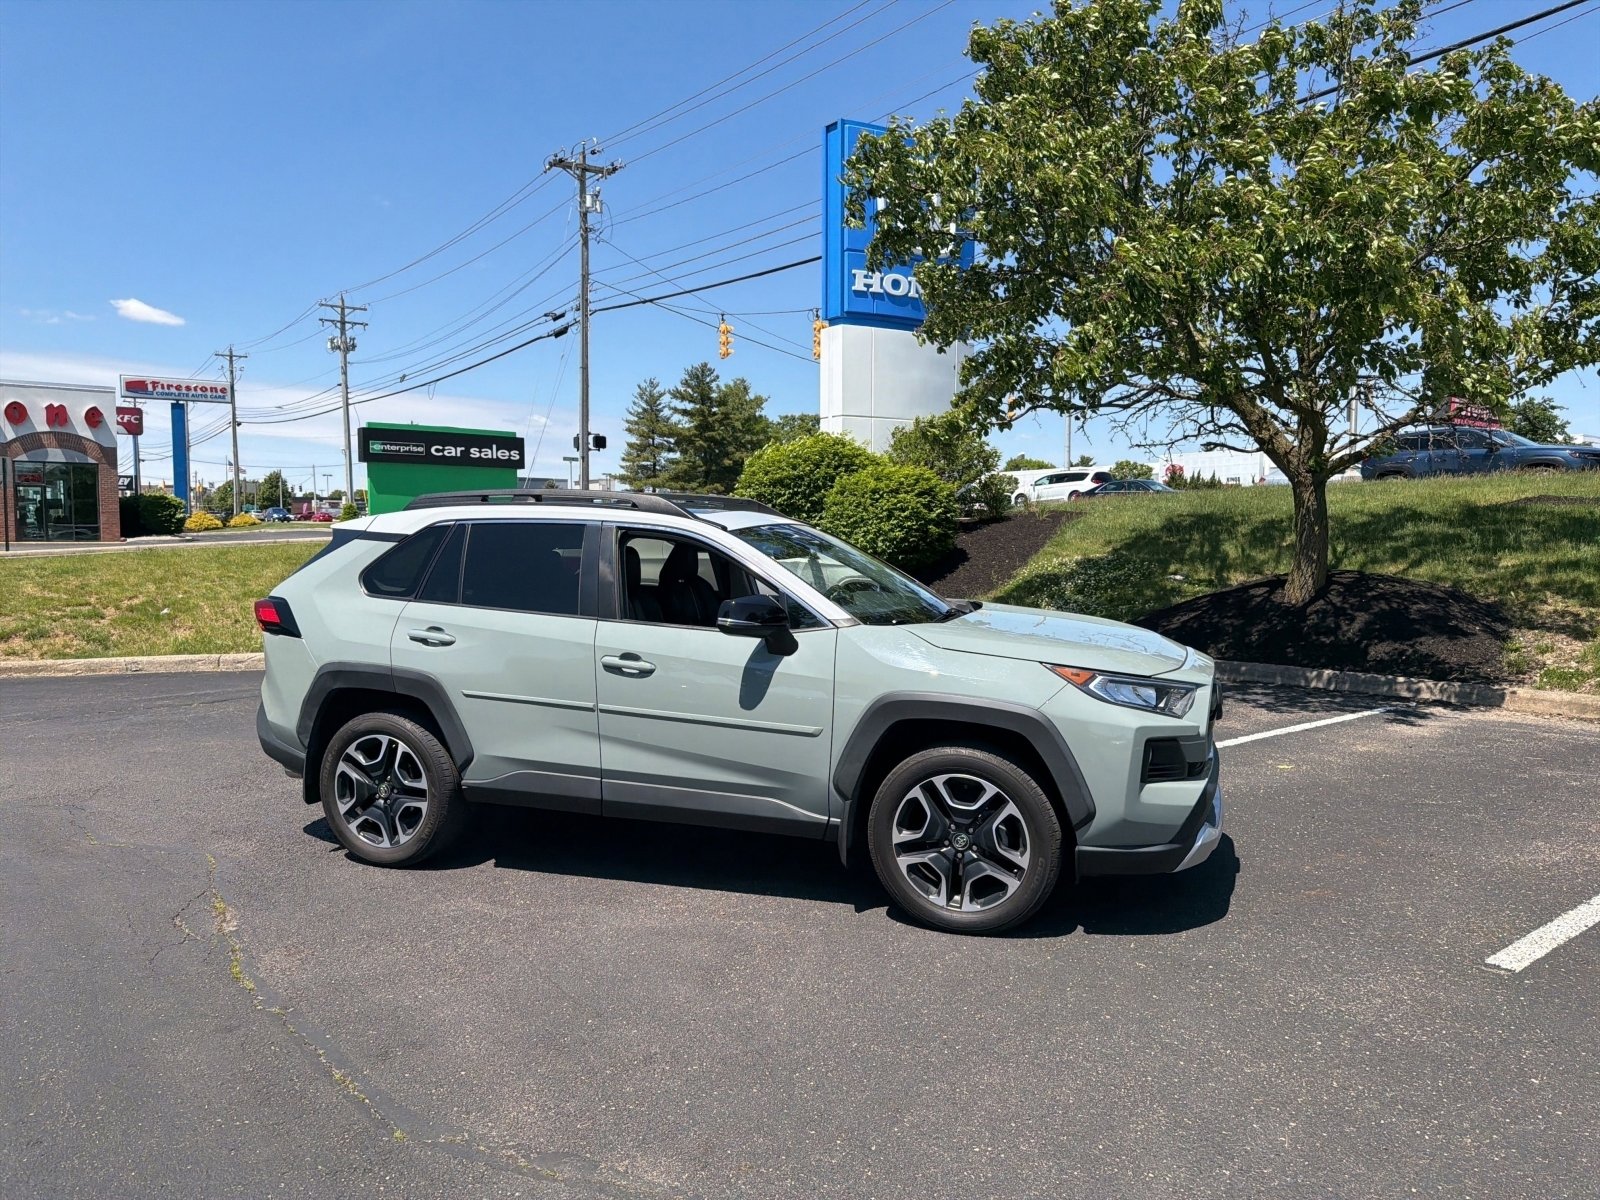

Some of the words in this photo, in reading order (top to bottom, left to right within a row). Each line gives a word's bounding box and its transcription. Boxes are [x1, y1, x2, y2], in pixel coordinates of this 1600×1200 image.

[851, 269, 924, 297] HON
[149, 380, 228, 394] Firestone
[155, 391, 190, 399] COMPLETE
[116, 414, 140, 424] KFC
[372, 444, 424, 453] enterprise
[430, 445, 466, 457] car
[469, 444, 521, 461] sales
